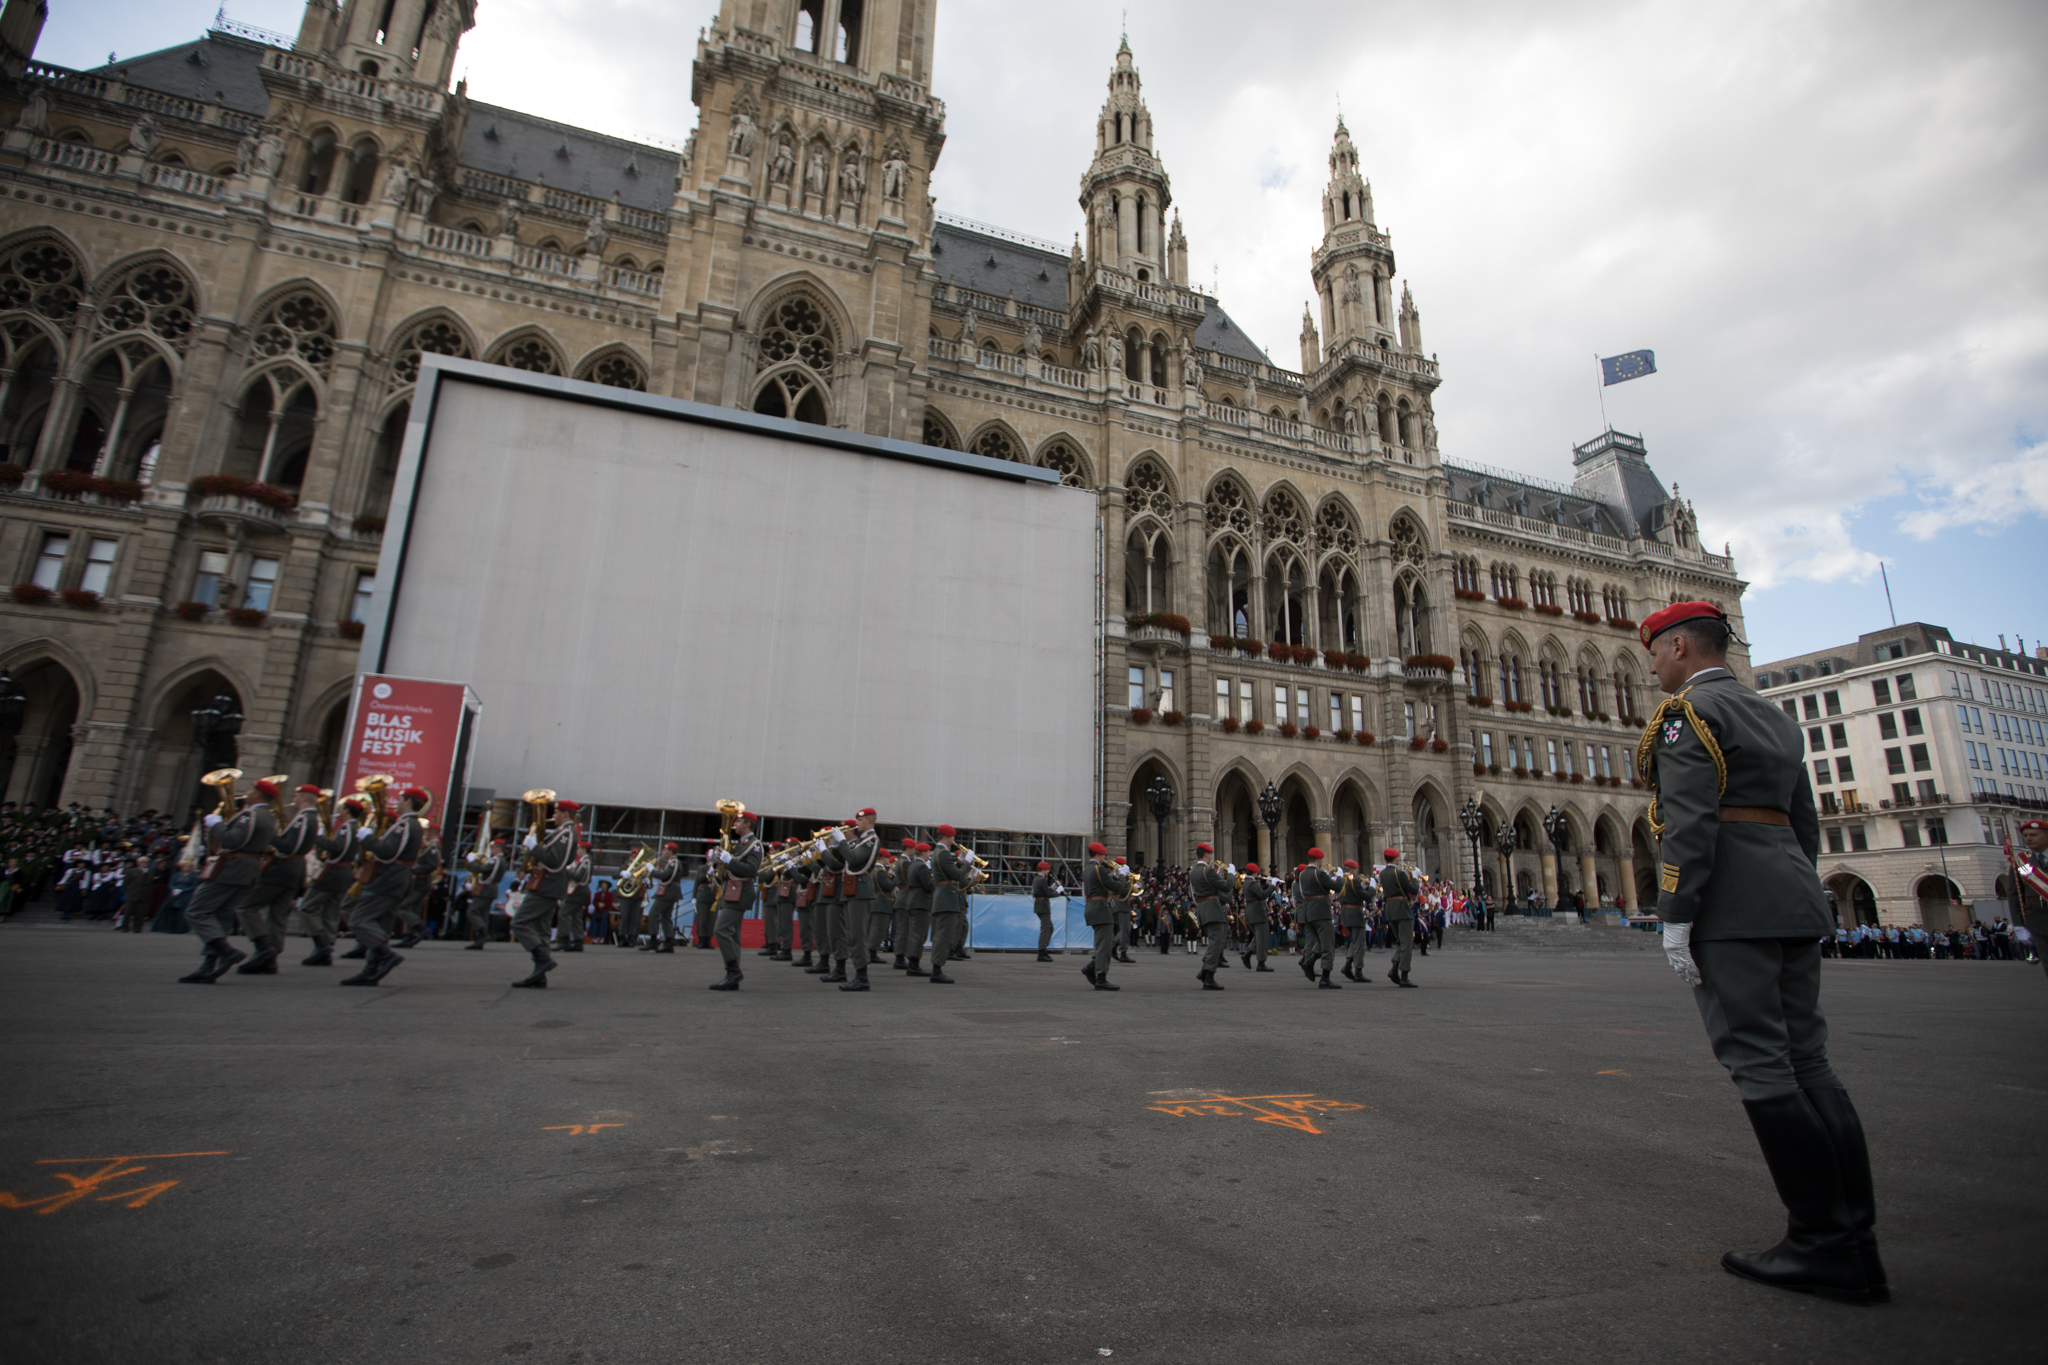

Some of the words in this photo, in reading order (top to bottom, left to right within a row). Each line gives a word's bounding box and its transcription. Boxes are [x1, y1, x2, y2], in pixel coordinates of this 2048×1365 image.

[370, 700, 433, 713] Österreichisches
[367, 712, 412, 728] BLAS
[364, 727, 423, 743] MUSIK
[361, 740, 405, 755] FEST
[359, 757, 398, 767] Blasmusik
